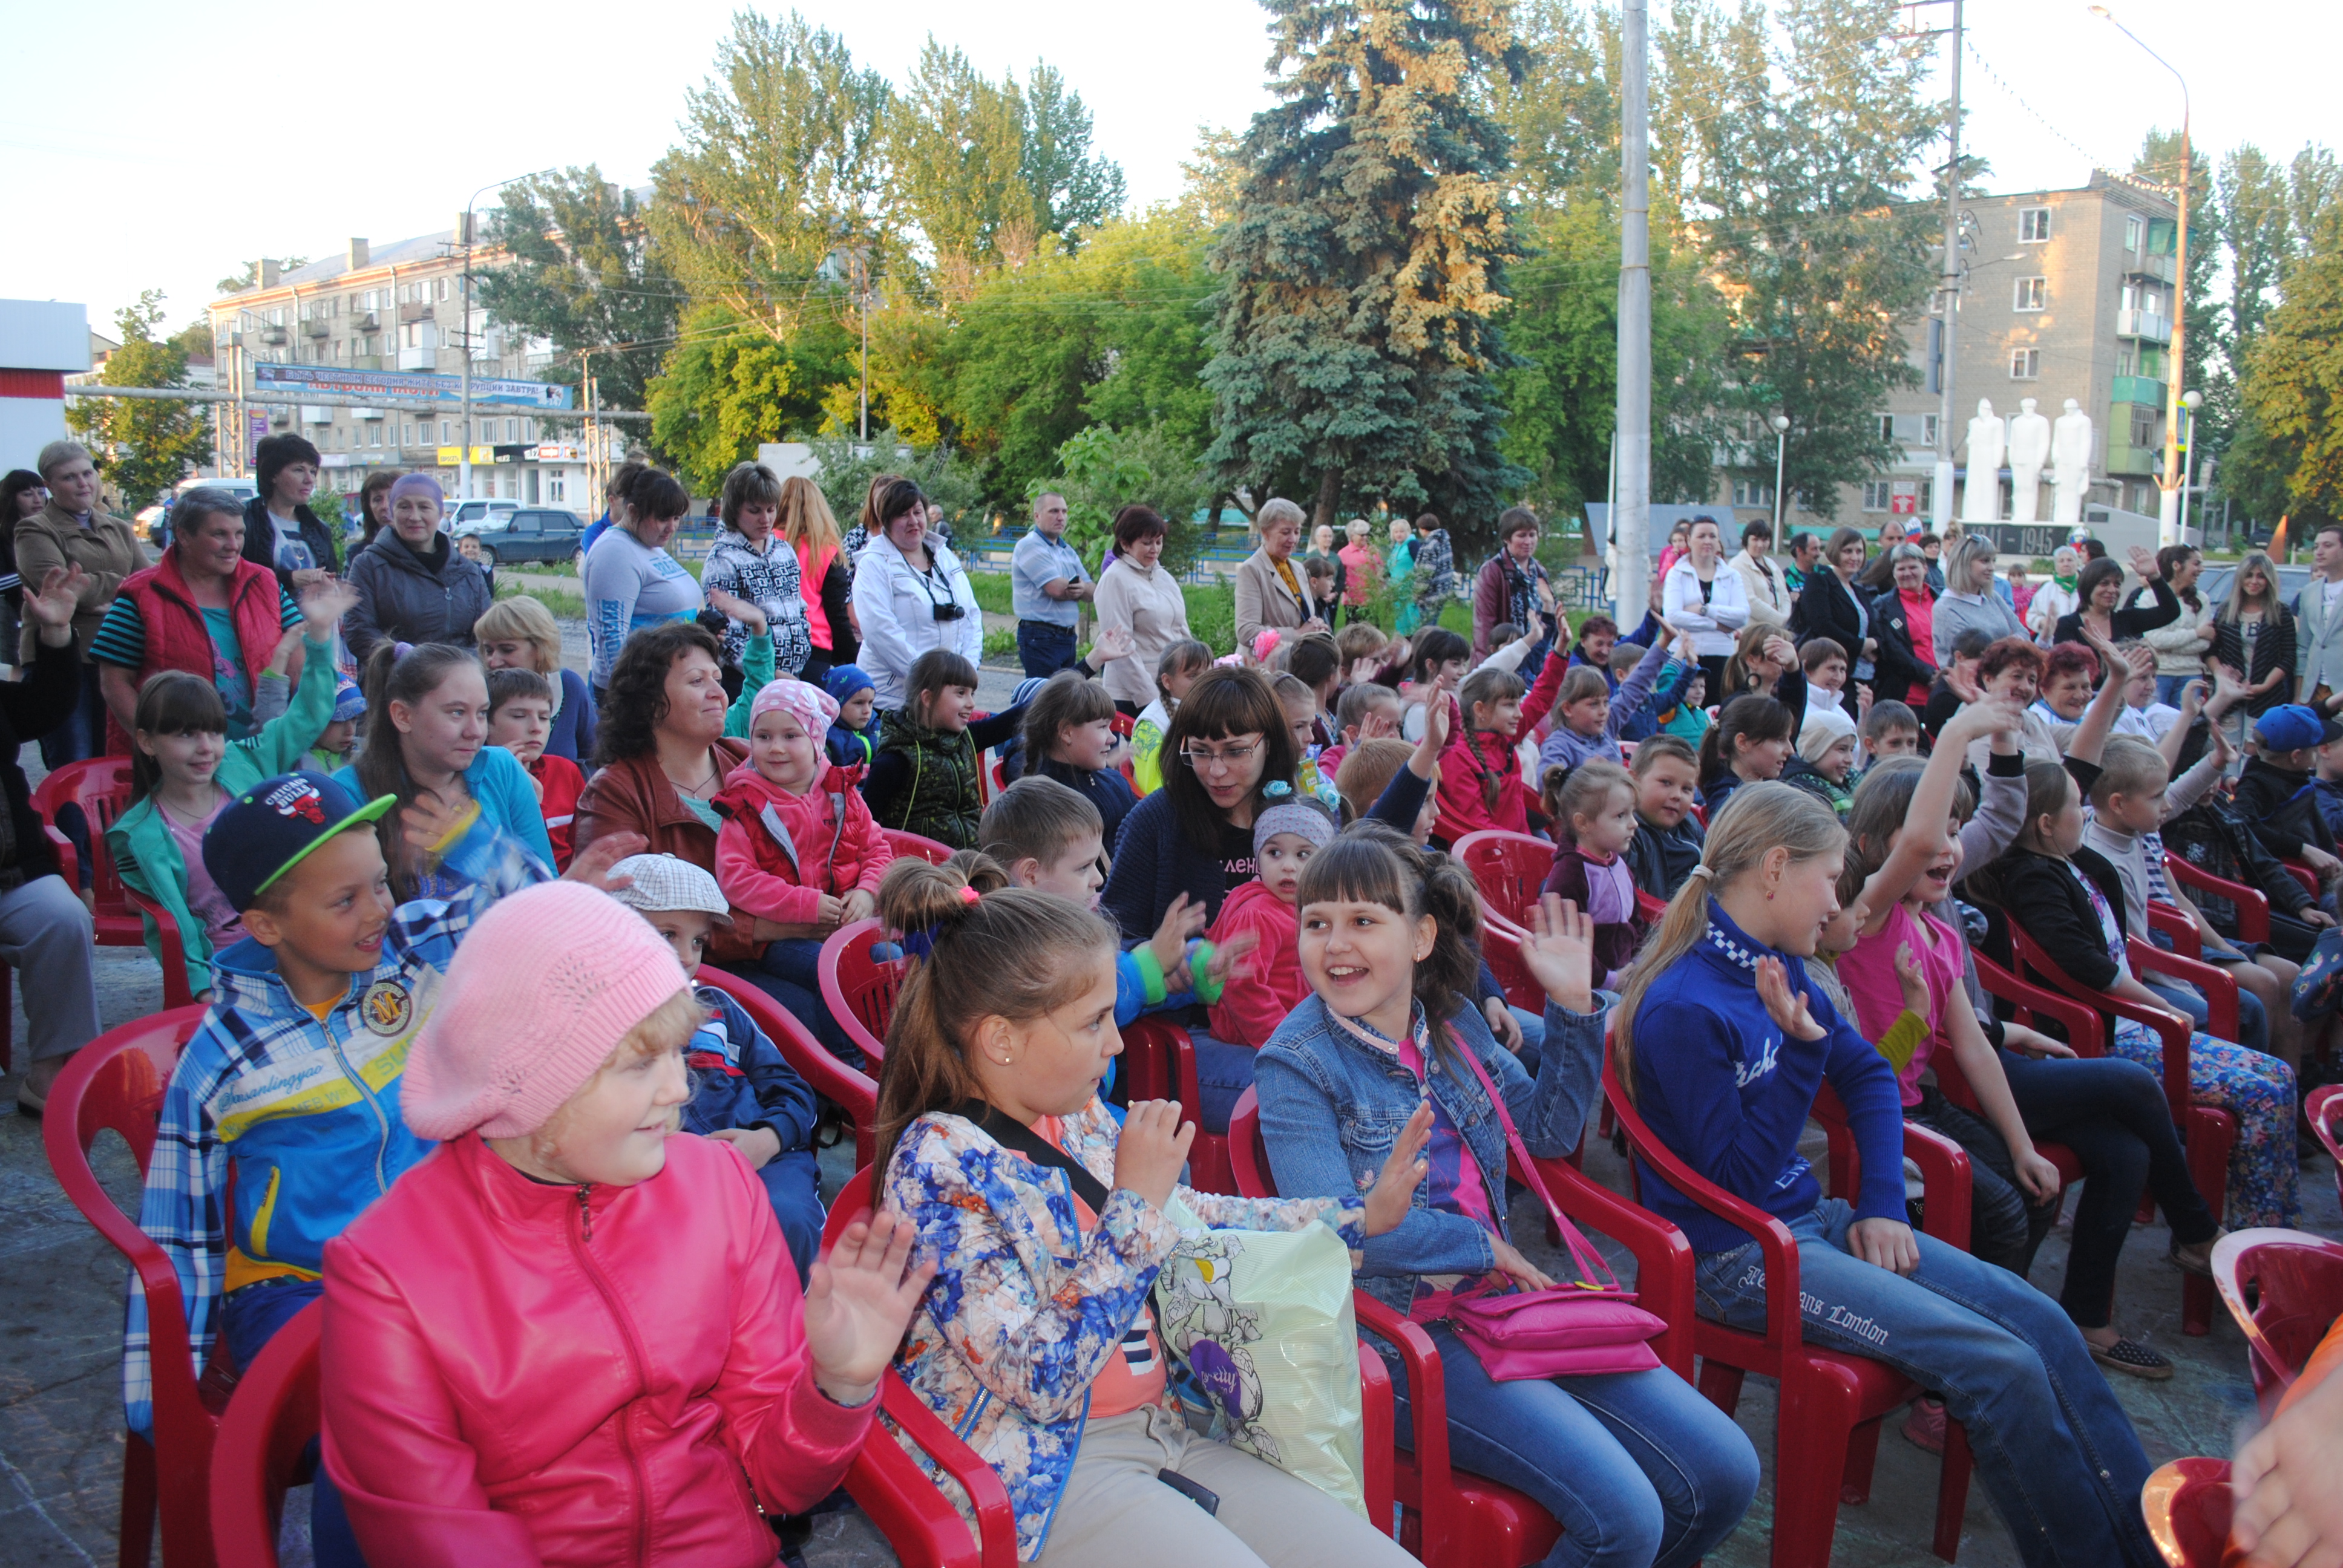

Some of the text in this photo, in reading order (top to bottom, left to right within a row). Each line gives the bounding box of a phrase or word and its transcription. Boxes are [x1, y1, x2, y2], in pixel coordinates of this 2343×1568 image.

[286, 370, 539, 394] БЫТЬ ЧЕСТНЫМ СЕГОДНЯ ЖИТЬ БЕЗ КОРУПЦИИ ЗАВТРА!
[2020, 524, 2054, 555] 1945
[265, 778, 309, 806] CHICAGO
[277, 784, 312, 808] BULLS
[372, 991, 402, 1024] M
[1826, 1305, 1889, 1345] London
